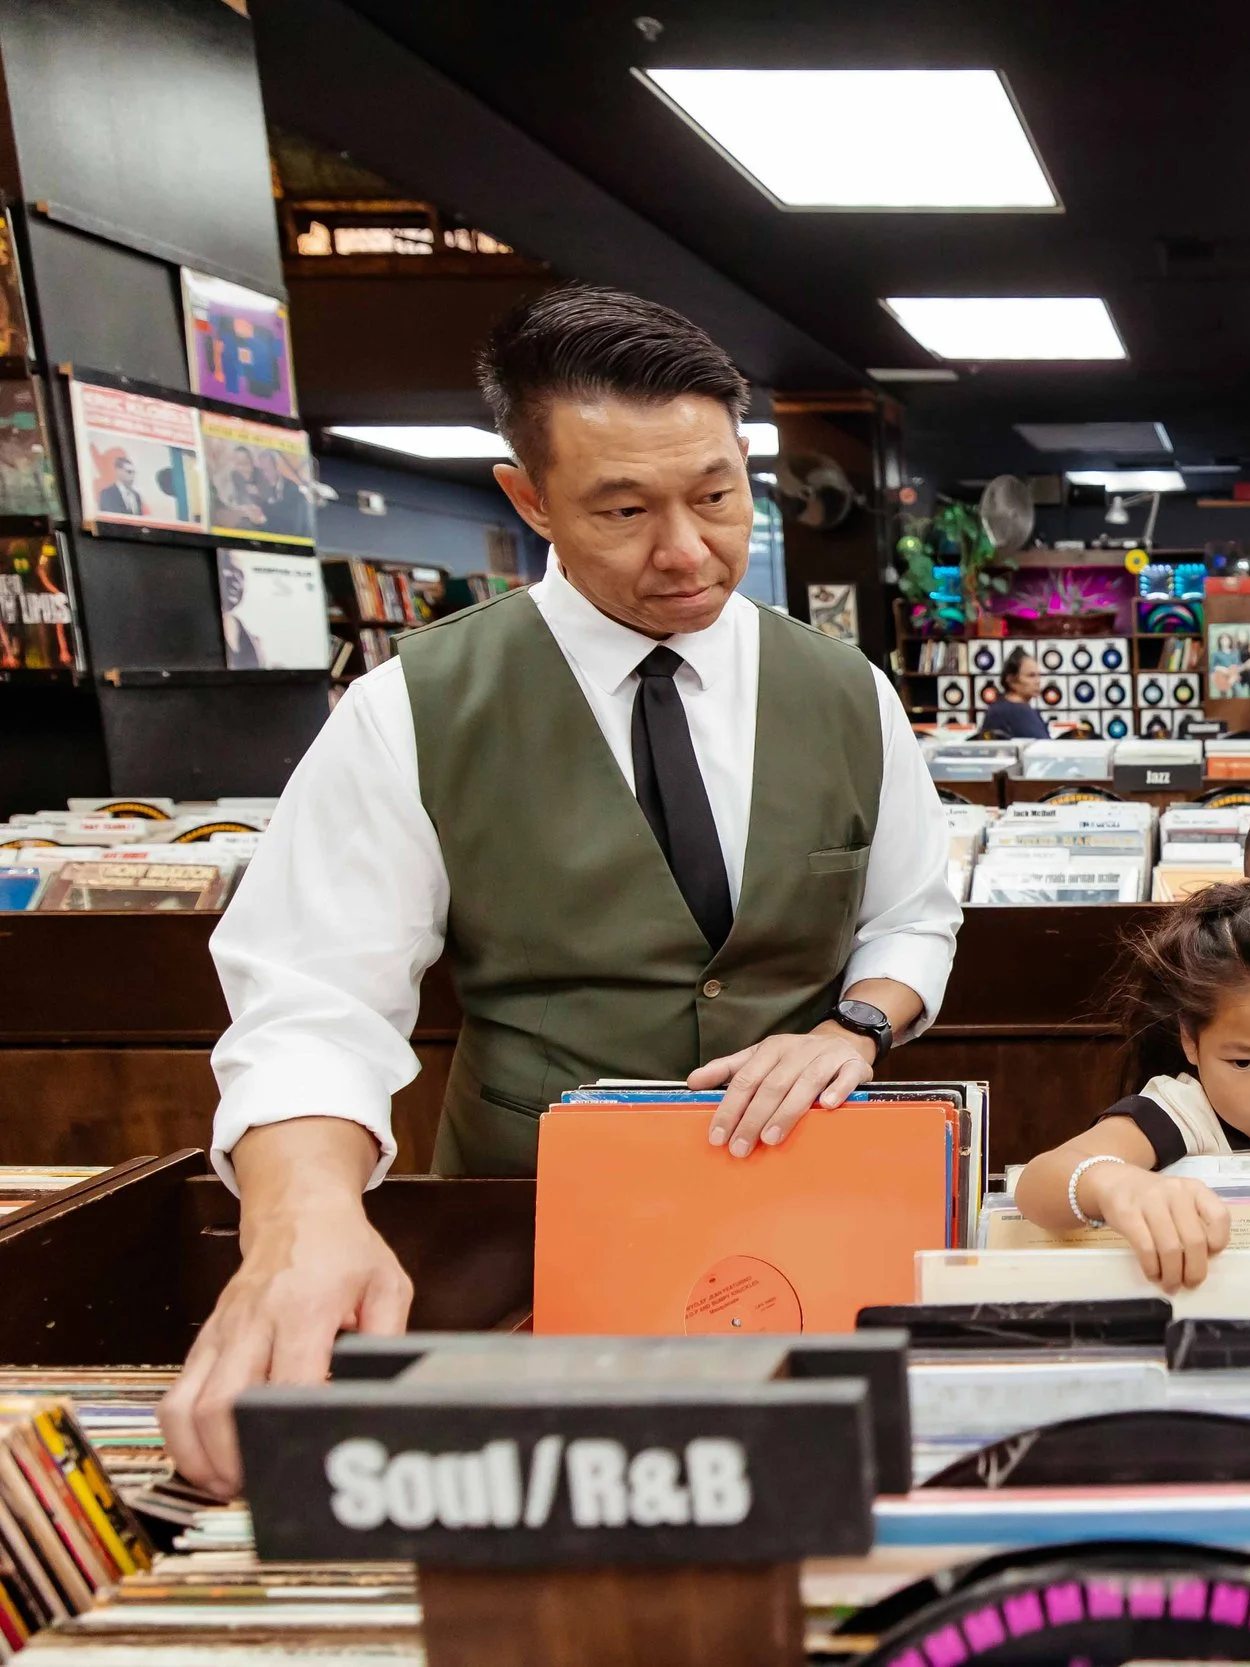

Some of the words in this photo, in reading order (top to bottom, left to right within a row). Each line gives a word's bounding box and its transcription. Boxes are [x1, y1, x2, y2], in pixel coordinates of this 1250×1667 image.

[1146, 770, 1171, 785] Jazz
[1030, 809, 1057, 817] McDuff
[324, 1433, 753, 1531] Soul/R&B
